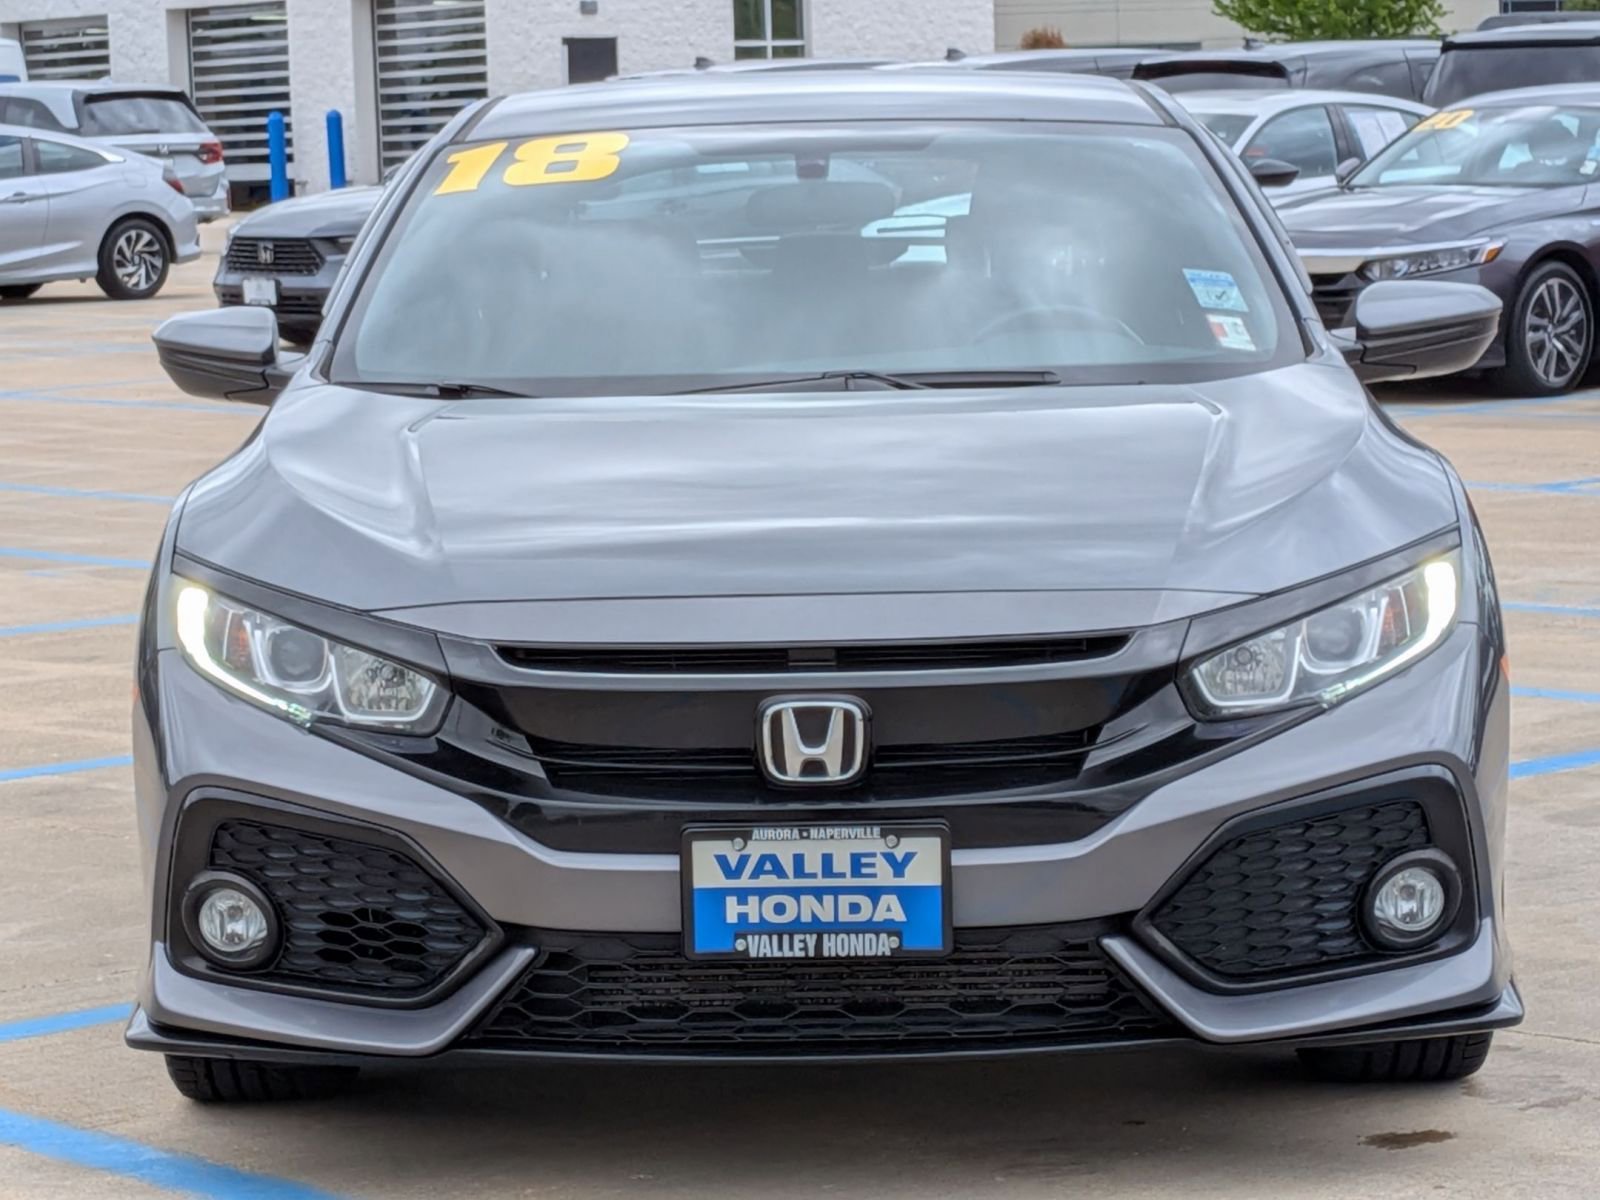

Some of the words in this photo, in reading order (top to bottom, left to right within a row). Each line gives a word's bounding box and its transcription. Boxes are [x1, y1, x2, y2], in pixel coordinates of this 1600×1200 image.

[434, 133, 628, 195] 18
[752, 827, 800, 841] AURORA
[810, 826, 881, 840] NAPERVILLE
[714, 852, 918, 880] VALLEY
[726, 895, 907, 923] HONDA
[747, 934, 817, 957] VALLEY
[824, 933, 892, 957] HONDA
